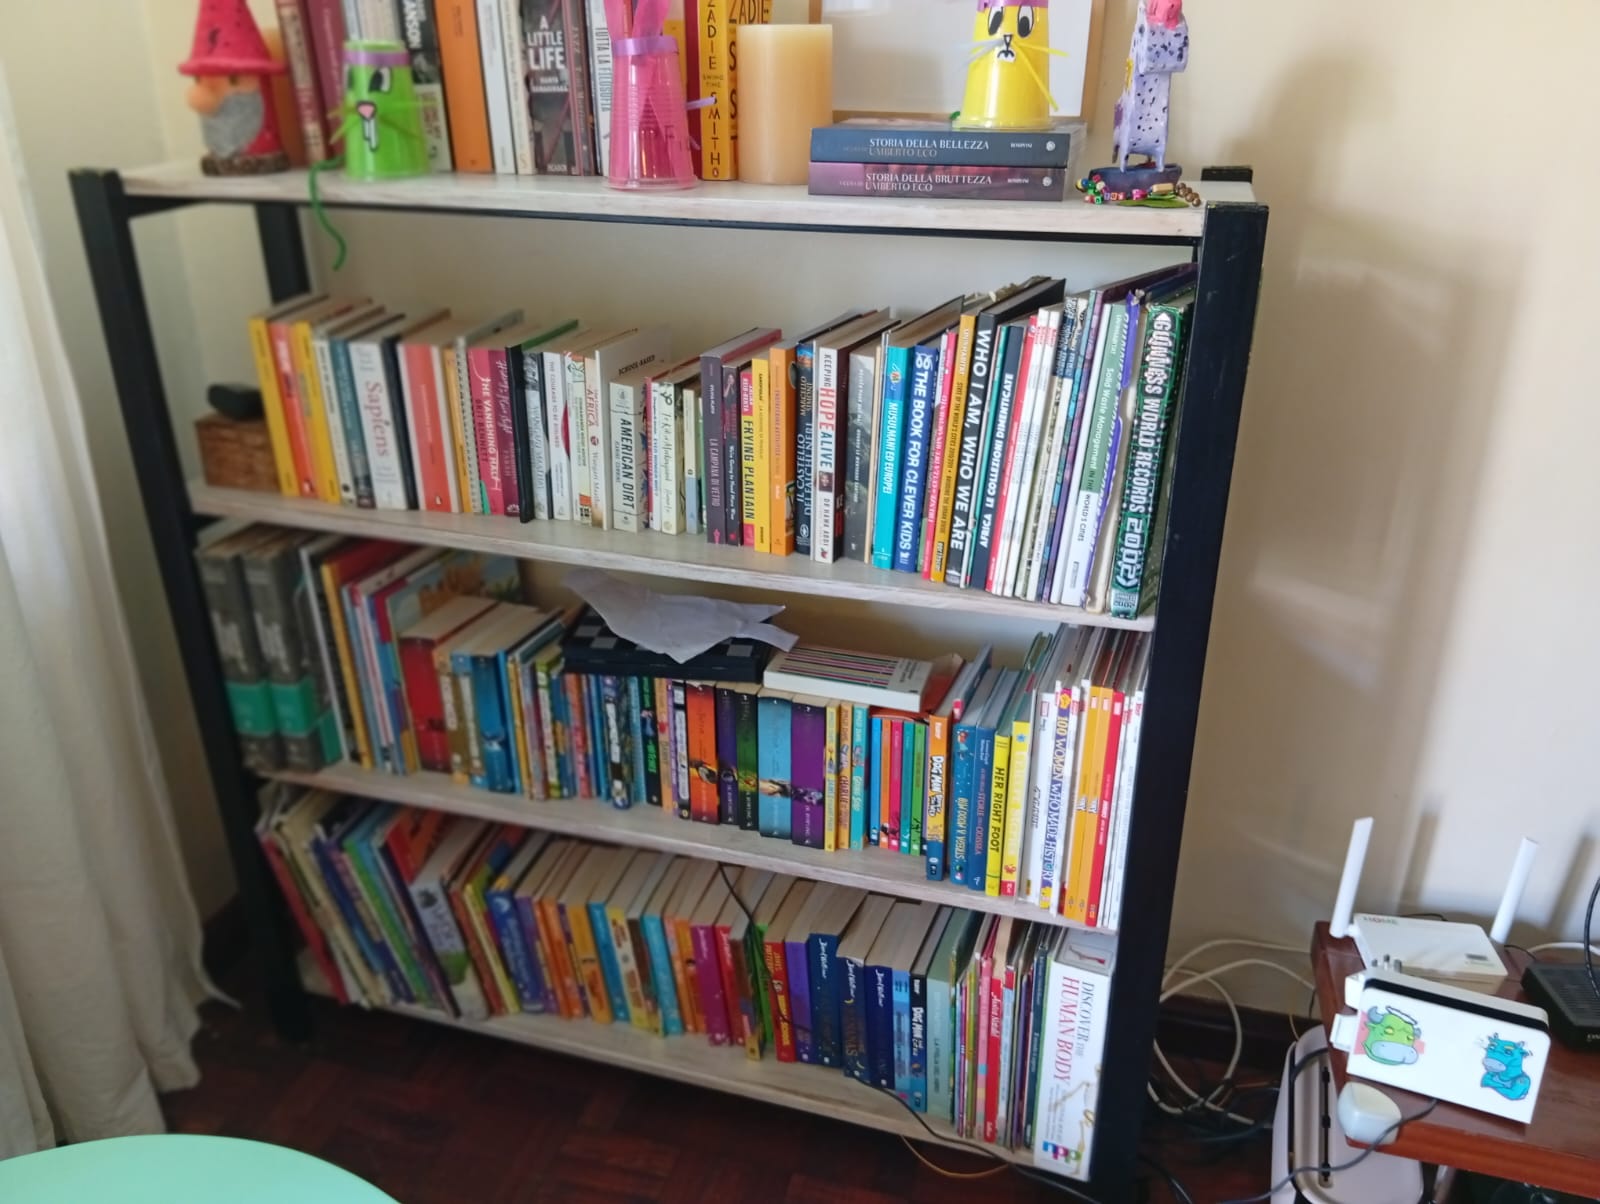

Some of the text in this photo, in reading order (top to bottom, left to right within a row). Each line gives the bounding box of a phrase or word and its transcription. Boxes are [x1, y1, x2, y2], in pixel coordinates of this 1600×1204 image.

[527, 31, 562, 46] LITTLE
[540, 16, 549, 30] A
[529, 47, 565, 70] LIFE
[868, 148, 914, 158] UMBERTO
[916, 148, 937, 158] ECO
[869, 138, 903, 150] STORIA
[905, 138, 937, 150] DELLA
[940, 139, 990, 151] BELLEZZA
[865, 182, 912, 192] UMBERTO
[913, 182, 934, 192] ECO
[866, 172, 898, 183] STORIA
[899, 173, 932, 184] DELLA
[935, 174, 992, 185] BRUTTEZZA
[973, 329, 992, 377] WHO
[1144, 320, 1172, 394] GUINNESS
[1103, 368, 1115, 388] Solid
[365, 381, 391, 456] Sapiens
[586, 389, 595, 427] AFRICA
[819, 354, 836, 469] KEEPING HOPE ALIVE
[964, 394, 985, 429] AM,
[996, 373, 1014, 439] DIMENTICATE
[1100, 390, 1112, 414] Waste
[481, 379, 498, 480] THE VANISHING HALF
[952, 412, 961, 431] WORLD'S
[1137, 399, 1162, 448] WORLD
[709, 438, 718, 447] LA
[883, 402, 898, 494] MUSULMANI ED EUROPEI
[959, 436, 977, 480] WHO
[1089, 416, 1105, 469] Management
[620, 418, 634, 509] AMERICAN DIRT
[710, 448, 719, 477] CAMPANA
[744, 420, 755, 519] FRYING PLANTAIN
[797, 434, 806, 492] CASTELLO
[900, 371, 928, 551] THE BOOK FOR CLEVER KIDS
[986, 440, 1005, 495] COLLEZIONI
[711, 487, 720, 507] VETRO
[955, 485, 971, 511] WE
[1087, 479, 1095, 490] THE
[1129, 451, 1155, 513] RECORDS
[1081, 494, 1091, 522] WORLD'S
[950, 515, 967, 550] ARE
[979, 513, 994, 548] AFRICA
[1077, 523, 1086, 542] CITIES
[1118, 517, 1143, 579] 2002
[930, 756, 944, 792] DOG MAN
[977, 792, 985, 816] STORIE
[990, 767, 1005, 853] HER RIGHT FOOT
[1041, 716, 1068, 881] 100 WOMEN WHO MADE HISTORY
[912, 1007, 924, 1040] DOG MAN
[1053, 976, 1080, 1085] HUMAN BODY
[1075, 981, 1095, 1058] DISCOVER THE
